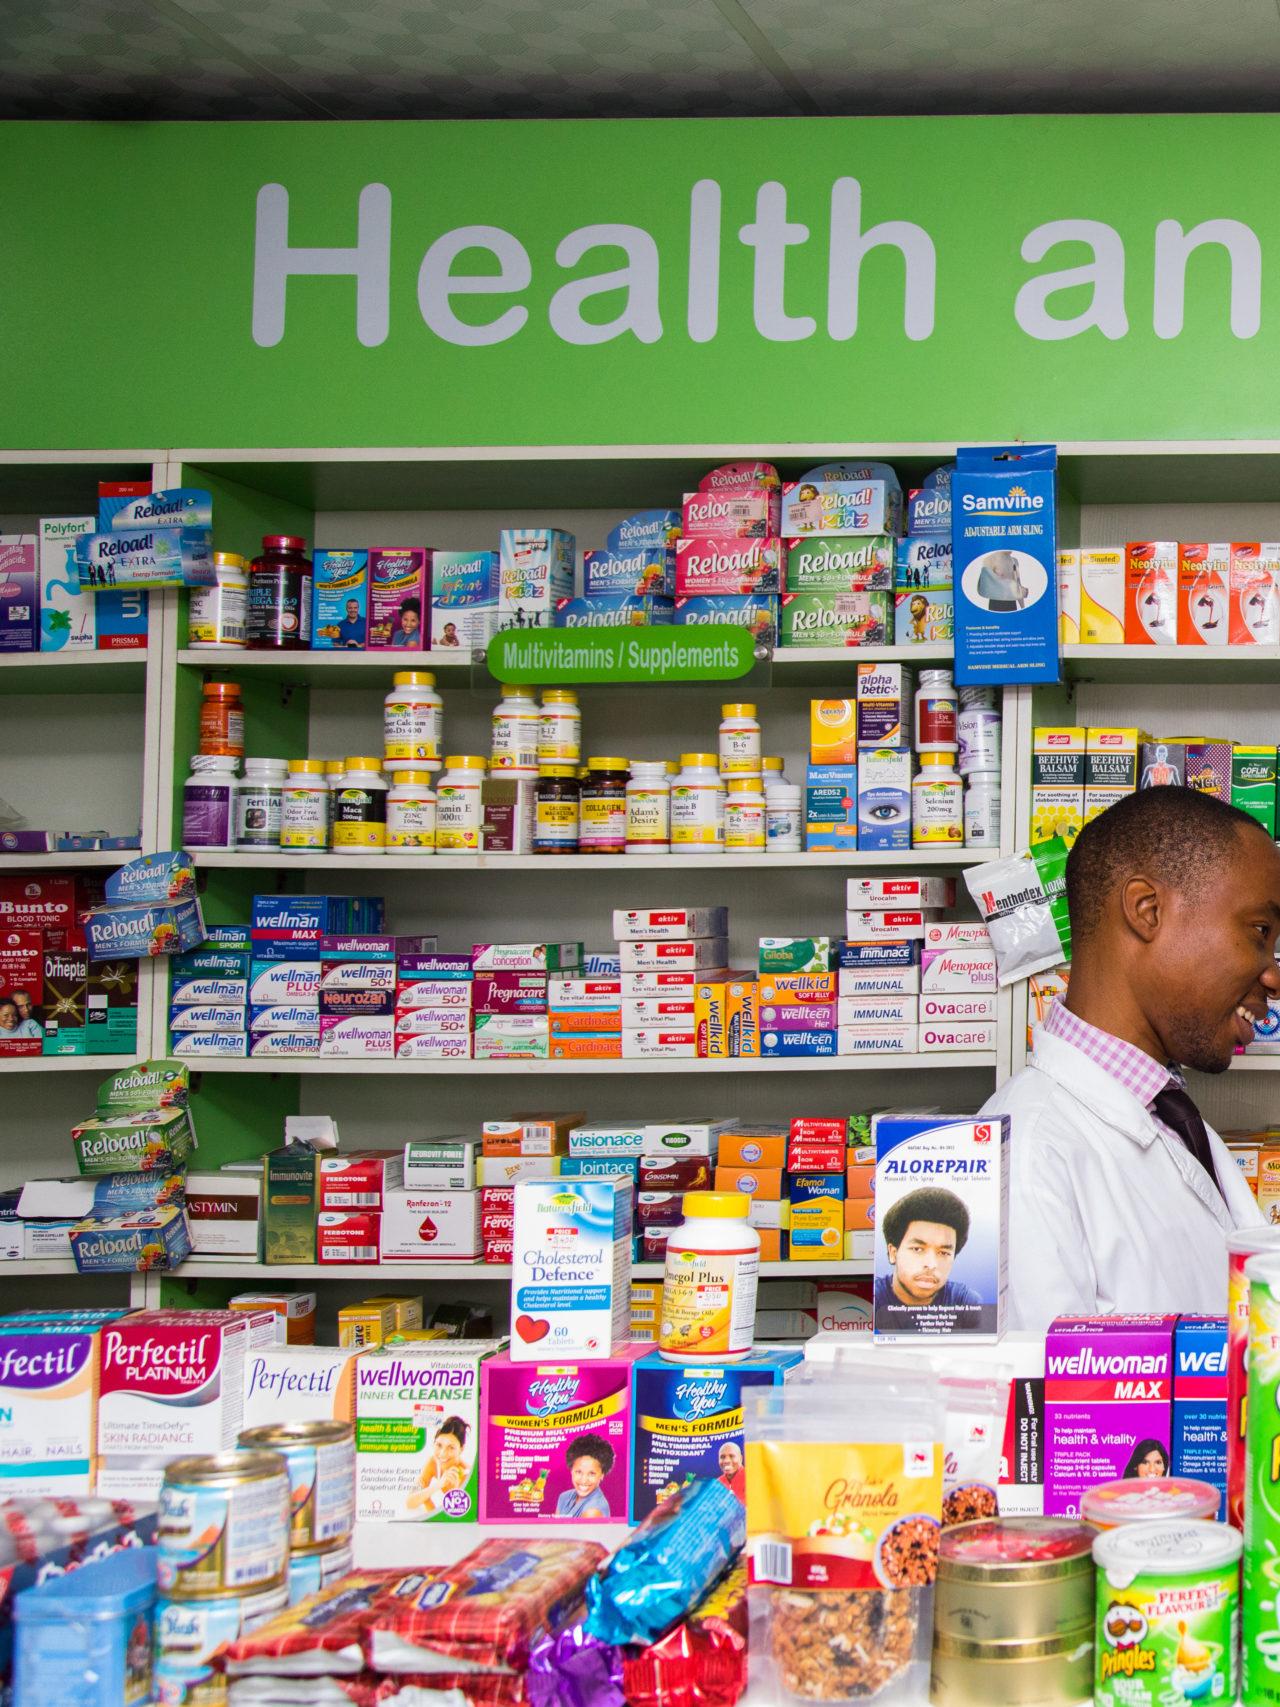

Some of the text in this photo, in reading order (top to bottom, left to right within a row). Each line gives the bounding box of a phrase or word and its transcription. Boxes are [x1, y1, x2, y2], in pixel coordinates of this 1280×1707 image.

[248, 176, 936, 348] Health
[133, 498, 184, 520] Reload!
[962, 493, 1043, 512] Samvine
[44, 522, 86, 534] Polyfort
[964, 525, 1043, 536] ADJUSTABLE ARM SLING
[98, 534, 154, 558] Reload!
[686, 546, 760, 573] Reload!
[111, 637, 139, 645] PRISMA
[503, 639, 739, 669] Multivitamins / Supplements
[861, 675, 892, 686] alpha
[733, 741, 746, 749] B-6
[1038, 756, 1079, 764] BEEHIVE
[1040, 764, 1077, 773] BALSAM
[1241, 767, 1268, 776] COFLIN
[630, 808, 659, 817] Adam's
[631, 817, 656, 825] Desire
[982, 886, 1042, 914] Menthodex
[1, 902, 68, 913] Bunto
[257, 913, 319, 929] wellman
[658, 915, 678, 923] aktiv
[91, 916, 154, 940] Reload!
[293, 930, 317, 938] MAX
[764, 951, 793, 960] Giloba
[861, 948, 909, 958] immunace
[939, 959, 993, 972] Menopace
[776, 977, 829, 990] wellkid
[971, 971, 994, 983] plus
[416, 983, 467, 995] wellwoman
[489, 982, 545, 1000] Pregnacare
[854, 981, 903, 990] IMMUNAL
[324, 993, 386, 1004] Neurozan
[442, 995, 465, 1004] 50+
[781, 1008, 829, 1020] wellteen
[925, 1002, 986, 1016] Ovacare
[338, 1029, 391, 1039] wellwoman
[365, 1040, 391, 1048] PLUS
[81, 1130, 147, 1156] Reload!
[570, 1133, 643, 1148] visionace
[579, 1160, 635, 1176] Jointace
[885, 1160, 987, 1173] ALOREPAIR
[269, 1171, 313, 1181] Immunovite
[523, 1250, 603, 1265] Cholesterol
[532, 1268, 594, 1281] Defence
[105, 1331, 206, 1367] Perfectil
[1048, 1347, 1167, 1375] wellwoman
[126, 1366, 205, 1381] PLATINUM
[248, 1359, 338, 1400] Perfectil
[360, 1362, 474, 1387] wellwoman
[360, 1388, 473, 1401] INNER CLEANSE
[1114, 1381, 1163, 1399] MAX
[507, 1405, 604, 1427] WOMEN'S FORMULA
[103, 1432, 194, 1444] SKIN RADIANCE
[1054, 1434, 1136, 1445] health & vitality
